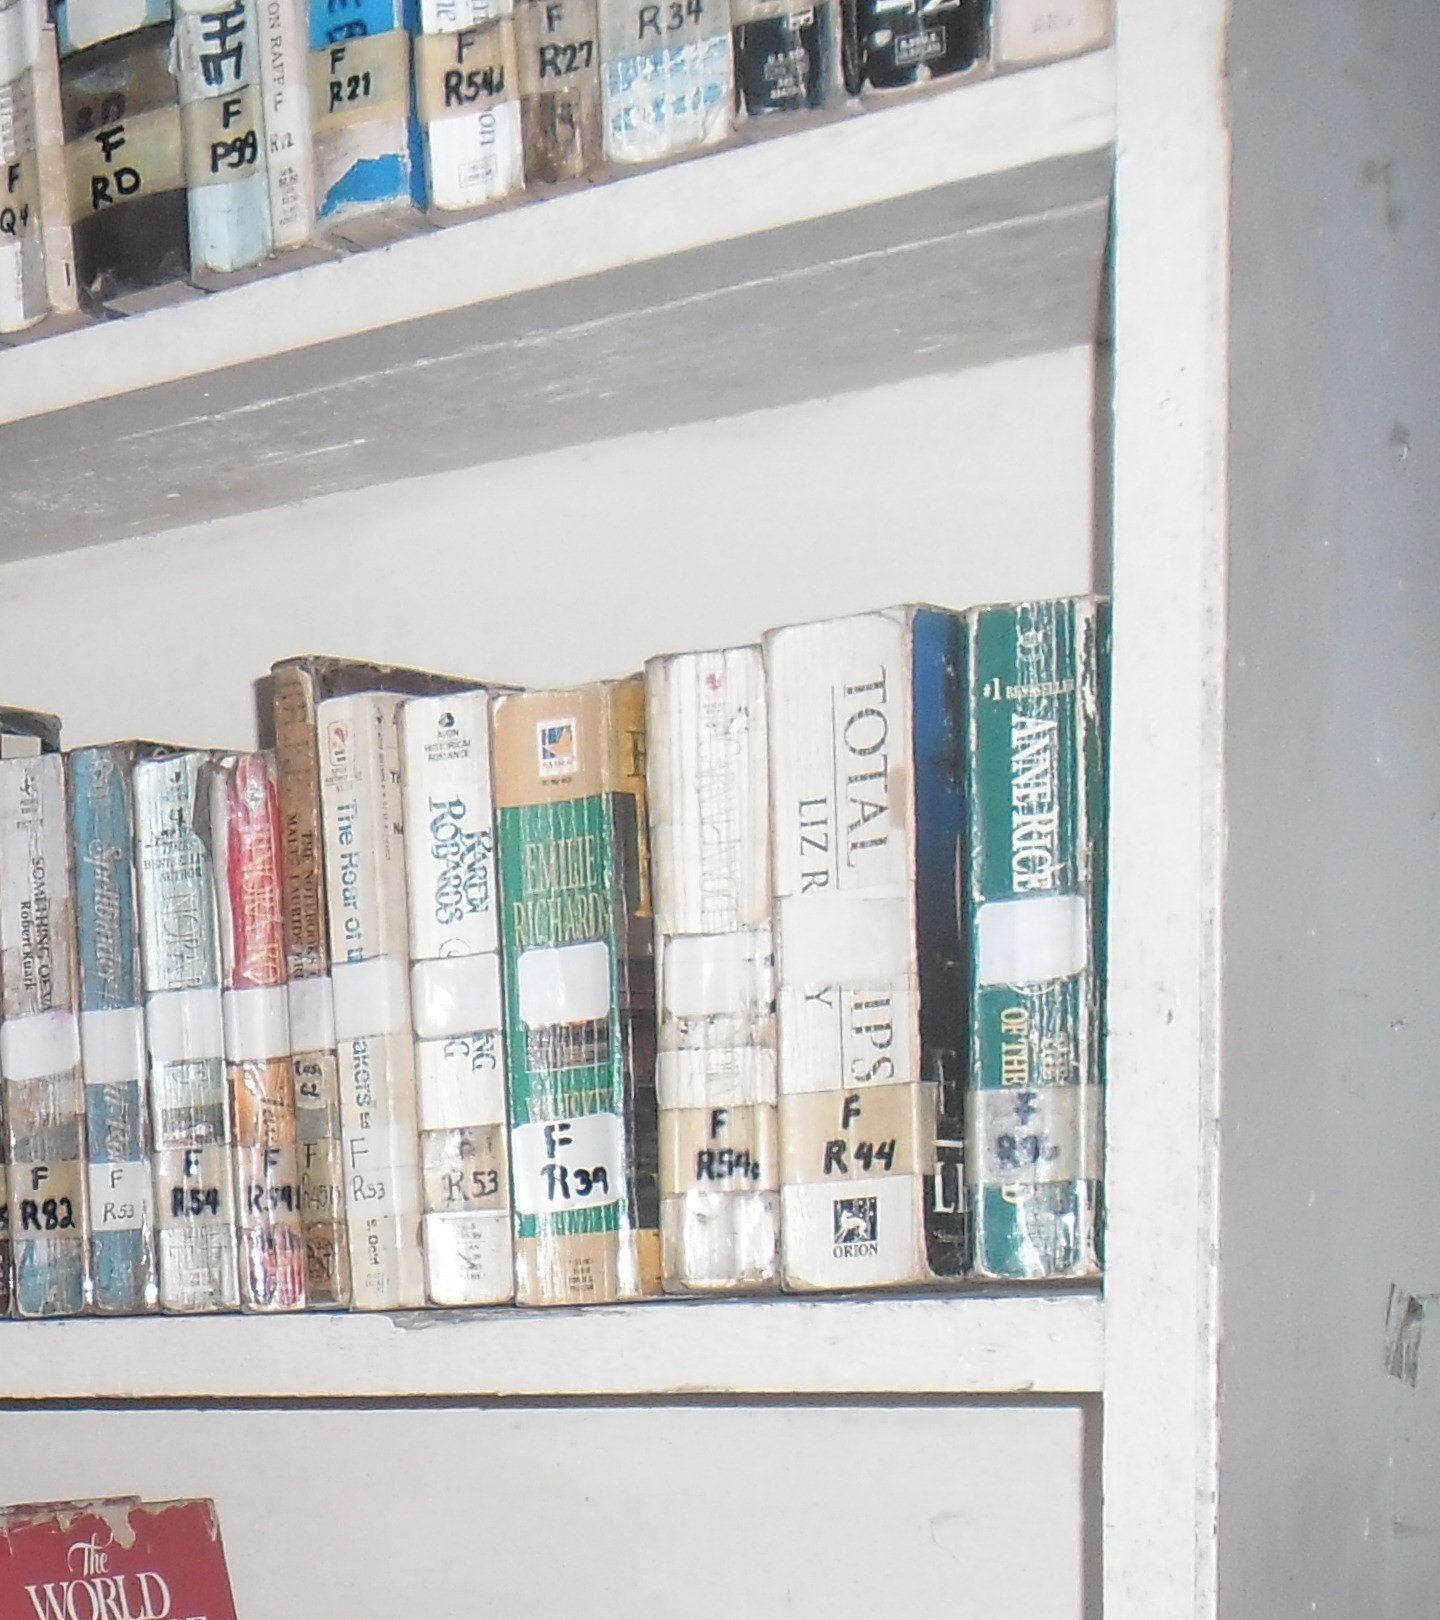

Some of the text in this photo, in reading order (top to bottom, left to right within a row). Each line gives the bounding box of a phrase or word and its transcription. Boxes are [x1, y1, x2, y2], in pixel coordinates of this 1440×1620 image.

[539, 41, 592, 78] R27
[983, 677, 1002, 702] #1
[843, 664, 889, 868] TOTAL
[1011, 713, 1058, 811] ANNE
[798, 797, 828, 856] LIZ
[428, 795, 465, 925] ROBARDS
[465, 827, 493, 915] KAREN
[524, 834, 597, 894] EMILIE
[841, 1094, 861, 1130] F
[544, 1122, 573, 1159] F
[823, 1139, 897, 1175] R44
[539, 1165, 609, 1201] R39
[22, 1198, 76, 1231] R82
[832, 1243, 878, 1259] ORION
[68, 1532, 111, 1577] The
